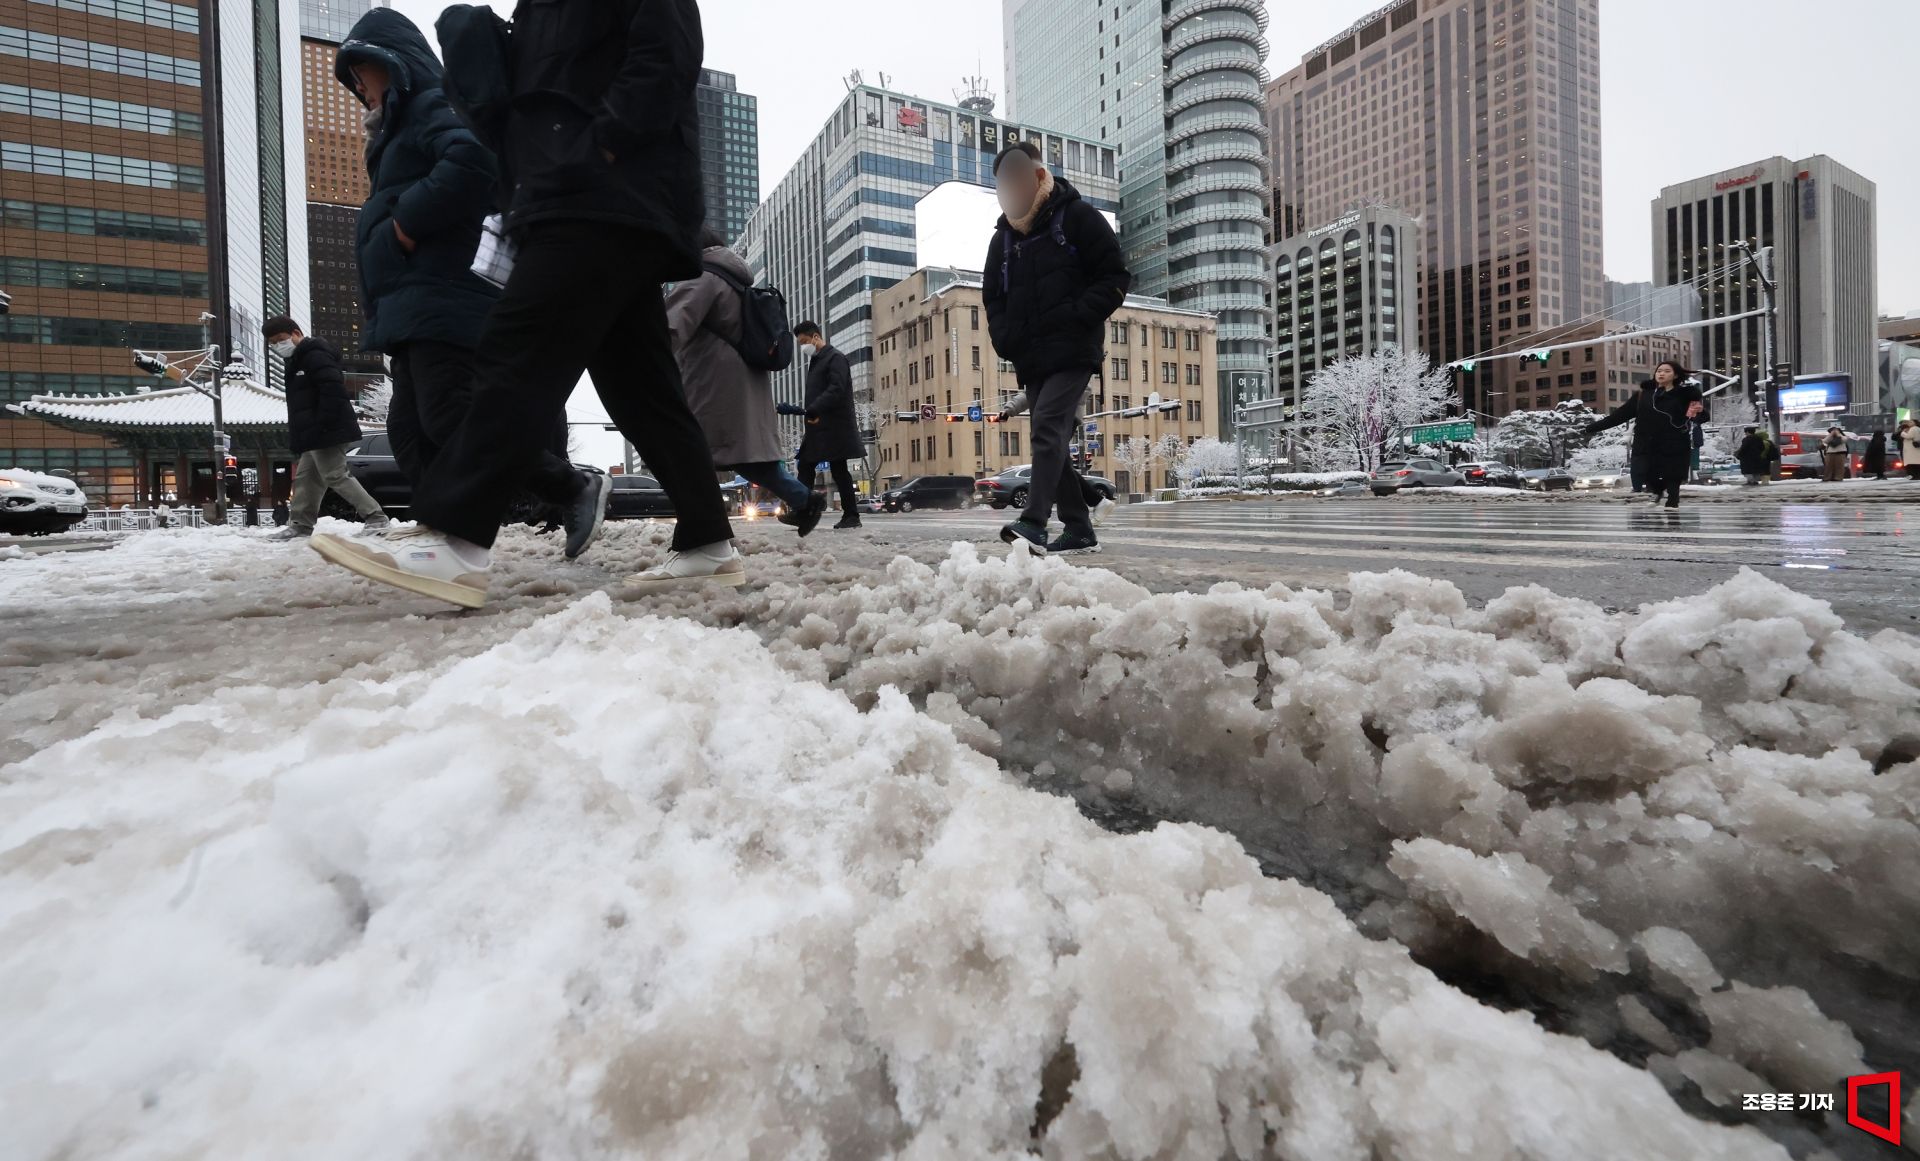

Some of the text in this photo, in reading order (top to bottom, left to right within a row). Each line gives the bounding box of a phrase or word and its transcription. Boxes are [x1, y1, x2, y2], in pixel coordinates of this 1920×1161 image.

[1324, 32, 1347, 50] SEOUL
[1348, 11, 1380, 35] FINANCE
[1307, 221, 1338, 239] Premier
[1338, 214, 1361, 227] Place
